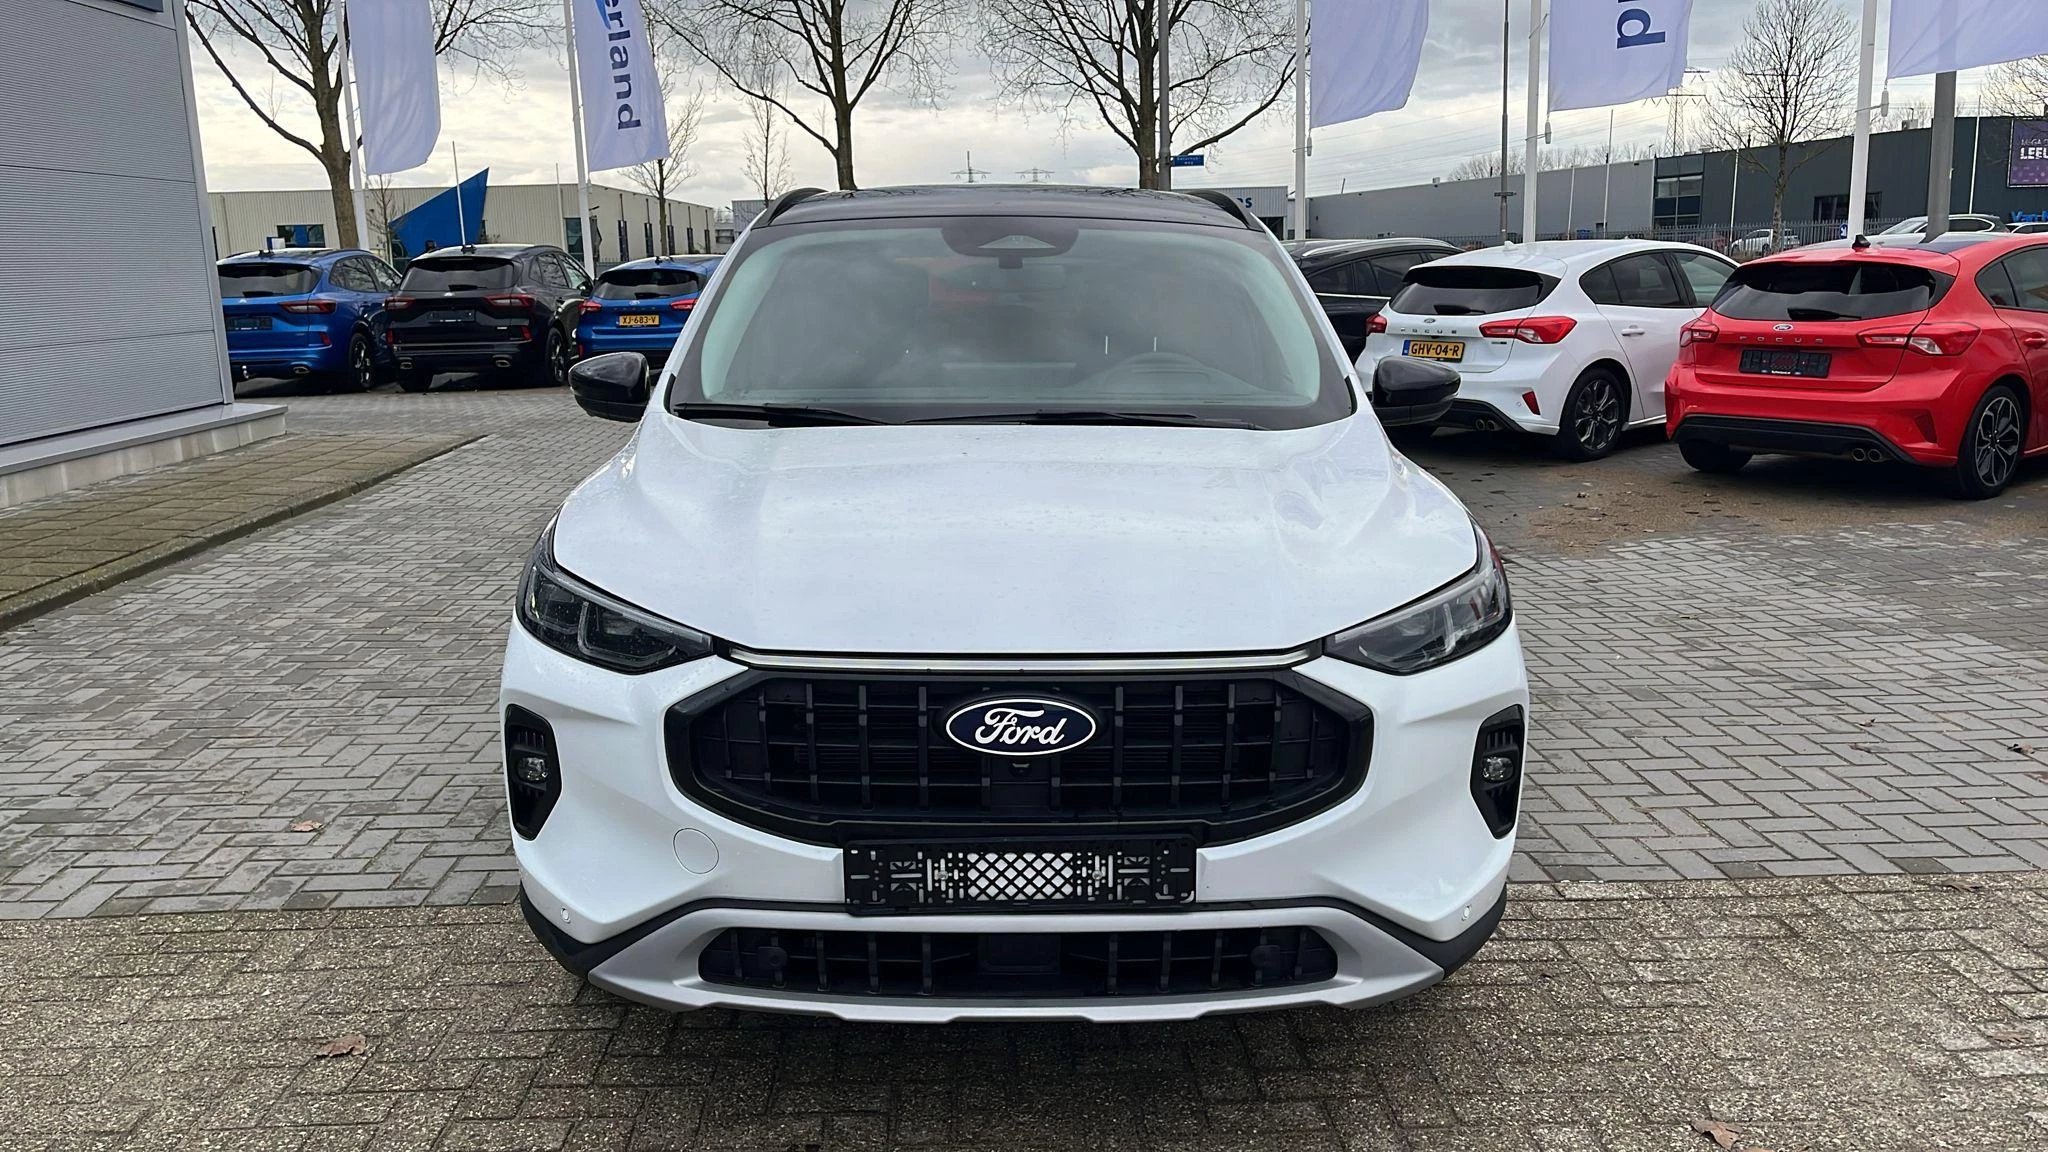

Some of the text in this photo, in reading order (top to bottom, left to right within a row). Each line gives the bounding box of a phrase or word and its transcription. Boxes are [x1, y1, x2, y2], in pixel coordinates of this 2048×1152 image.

[1236, 197, 1252, 208] S
[622, 316, 656, 325] XJ-683-V
[1411, 342, 1460, 356] GHV-04-R
[975, 708, 1067, 744] Ford
